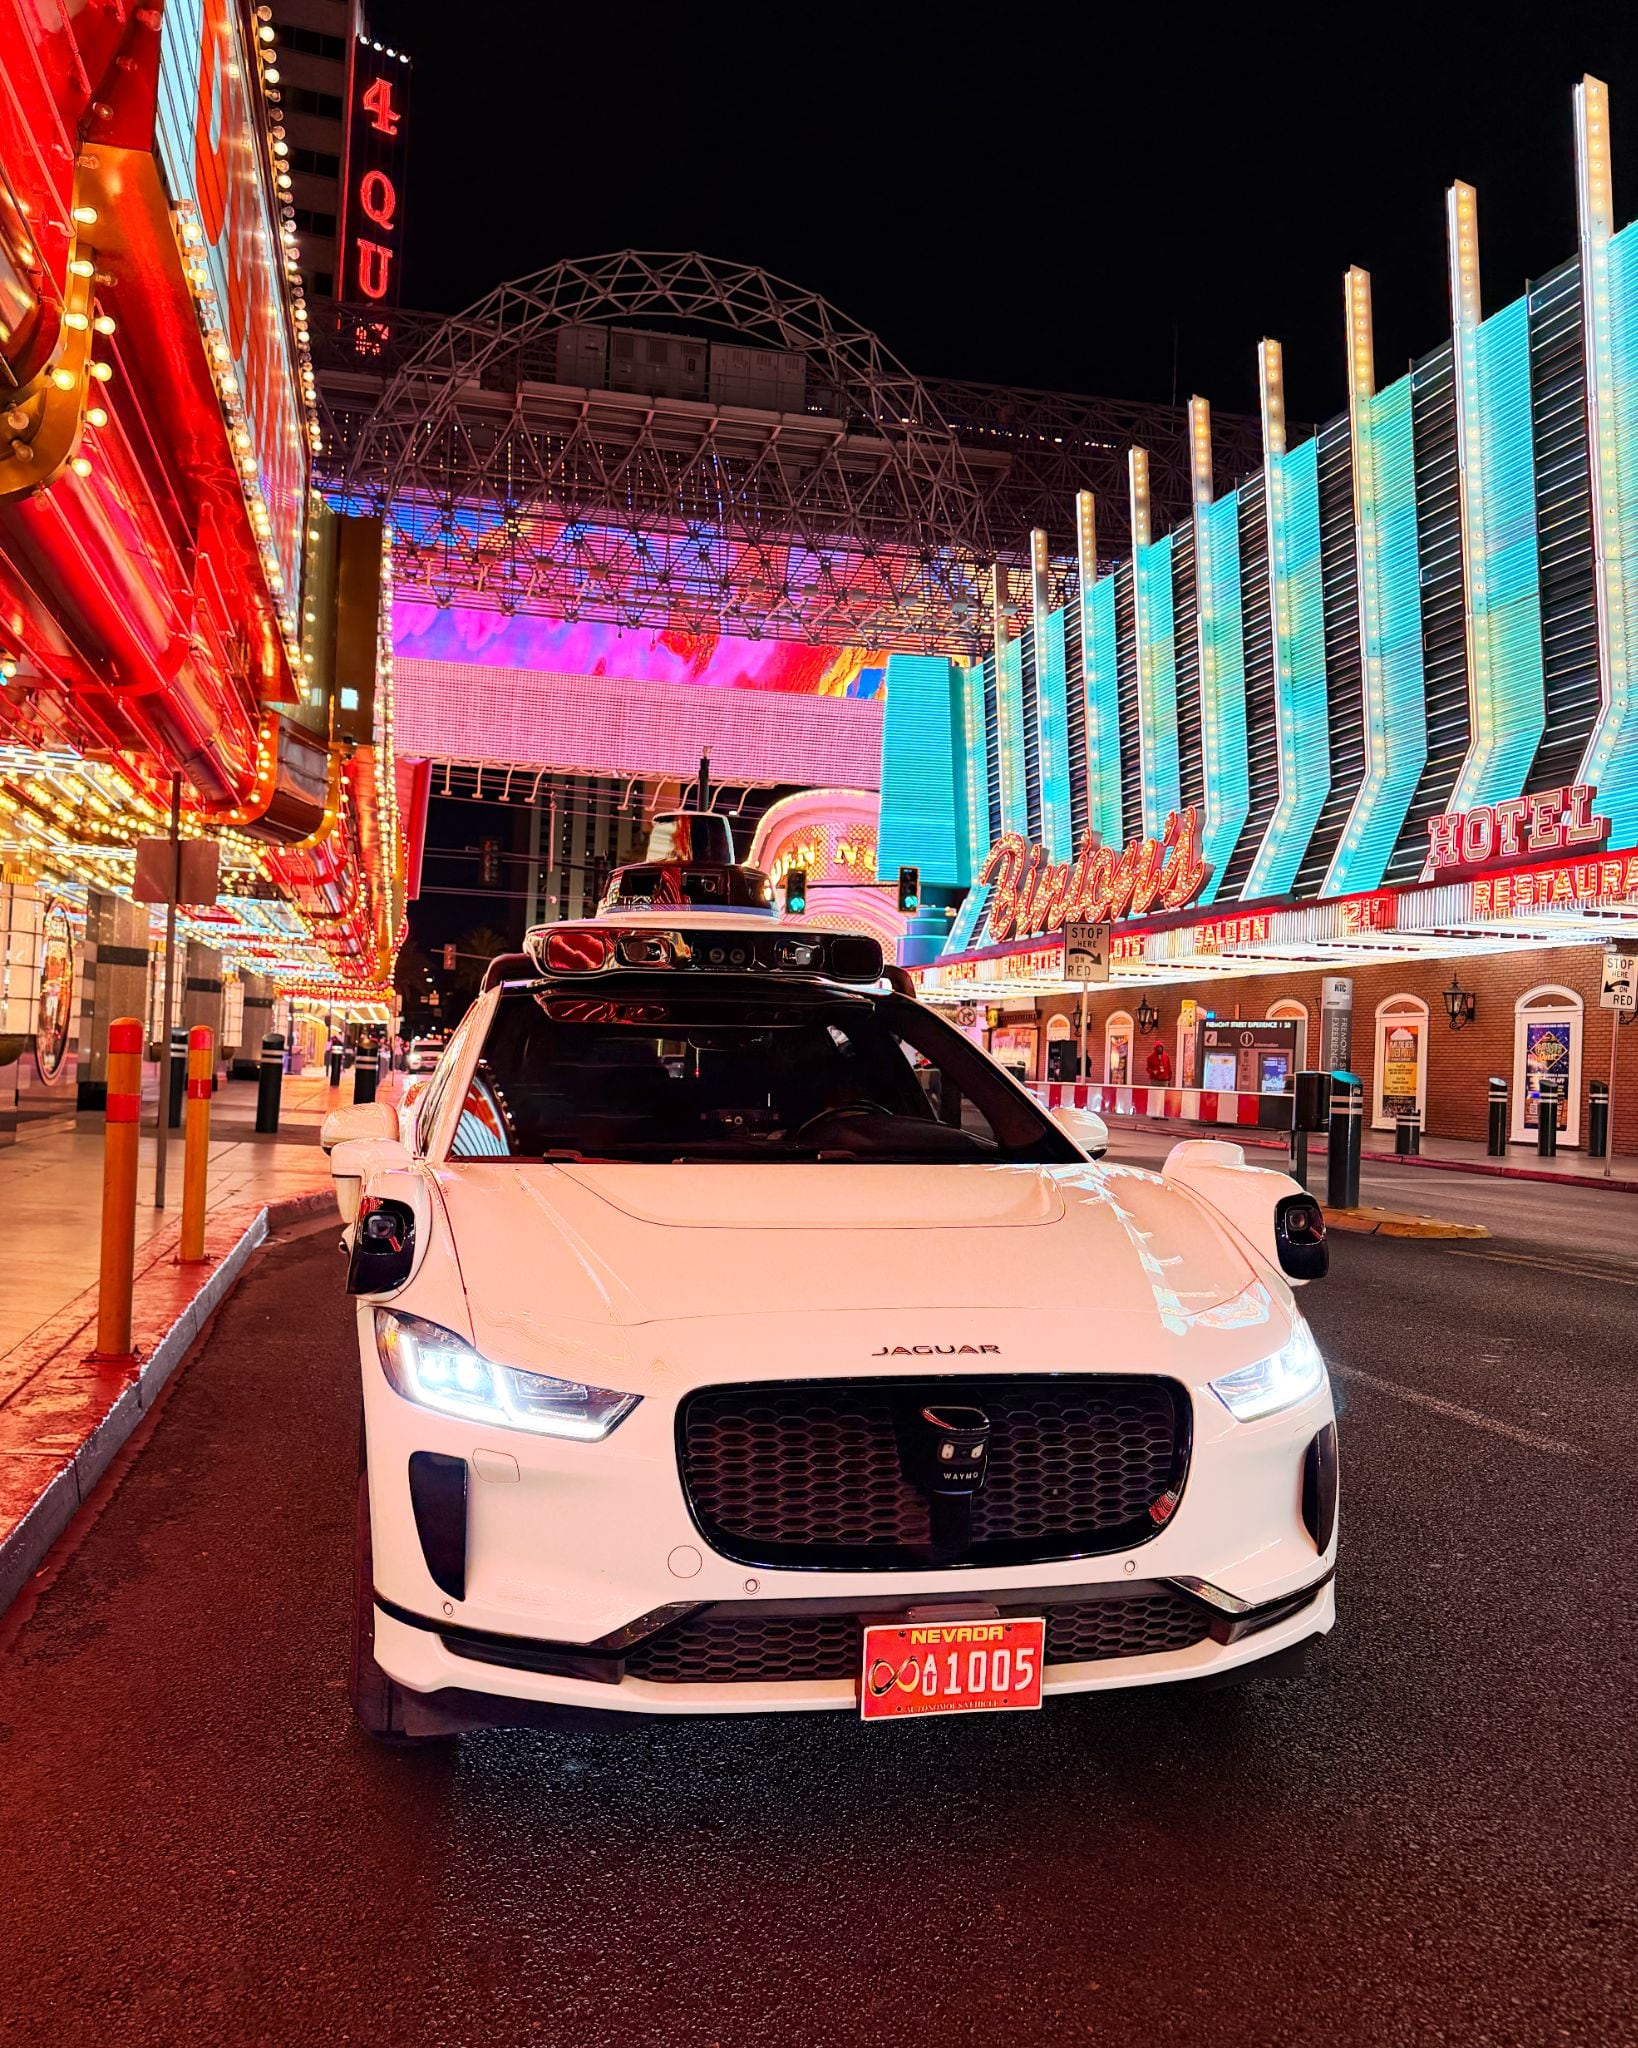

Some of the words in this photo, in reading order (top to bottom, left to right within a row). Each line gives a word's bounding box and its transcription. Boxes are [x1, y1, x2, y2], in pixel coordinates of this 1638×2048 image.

[363, 77, 401, 135] 4
[1427, 784, 1604, 869] HOTEL
[978, 805, 1206, 943] Binion's
[1071, 927, 1103, 939] STOP
[1194, 916, 1268, 947] SALOON
[1077, 940, 1097, 948] HERE
[1109, 935, 1142, 959] OTS
[1002, 950, 1062, 974] ROULETTE
[1067, 965, 1091, 977] RED
[1607, 957, 1635, 970] STOP
[1612, 970, 1629, 978] HERE
[1612, 994, 1633, 1006] RED
[1329, 1017, 1340, 1068] EXPERIENCE
[1340, 1017, 1348, 1060] FREMONT
[871, 1344, 1001, 1356] JAGUAR
[943, 1471, 979, 1480] WAYMO
[911, 1626, 1004, 1645] NEVADA
